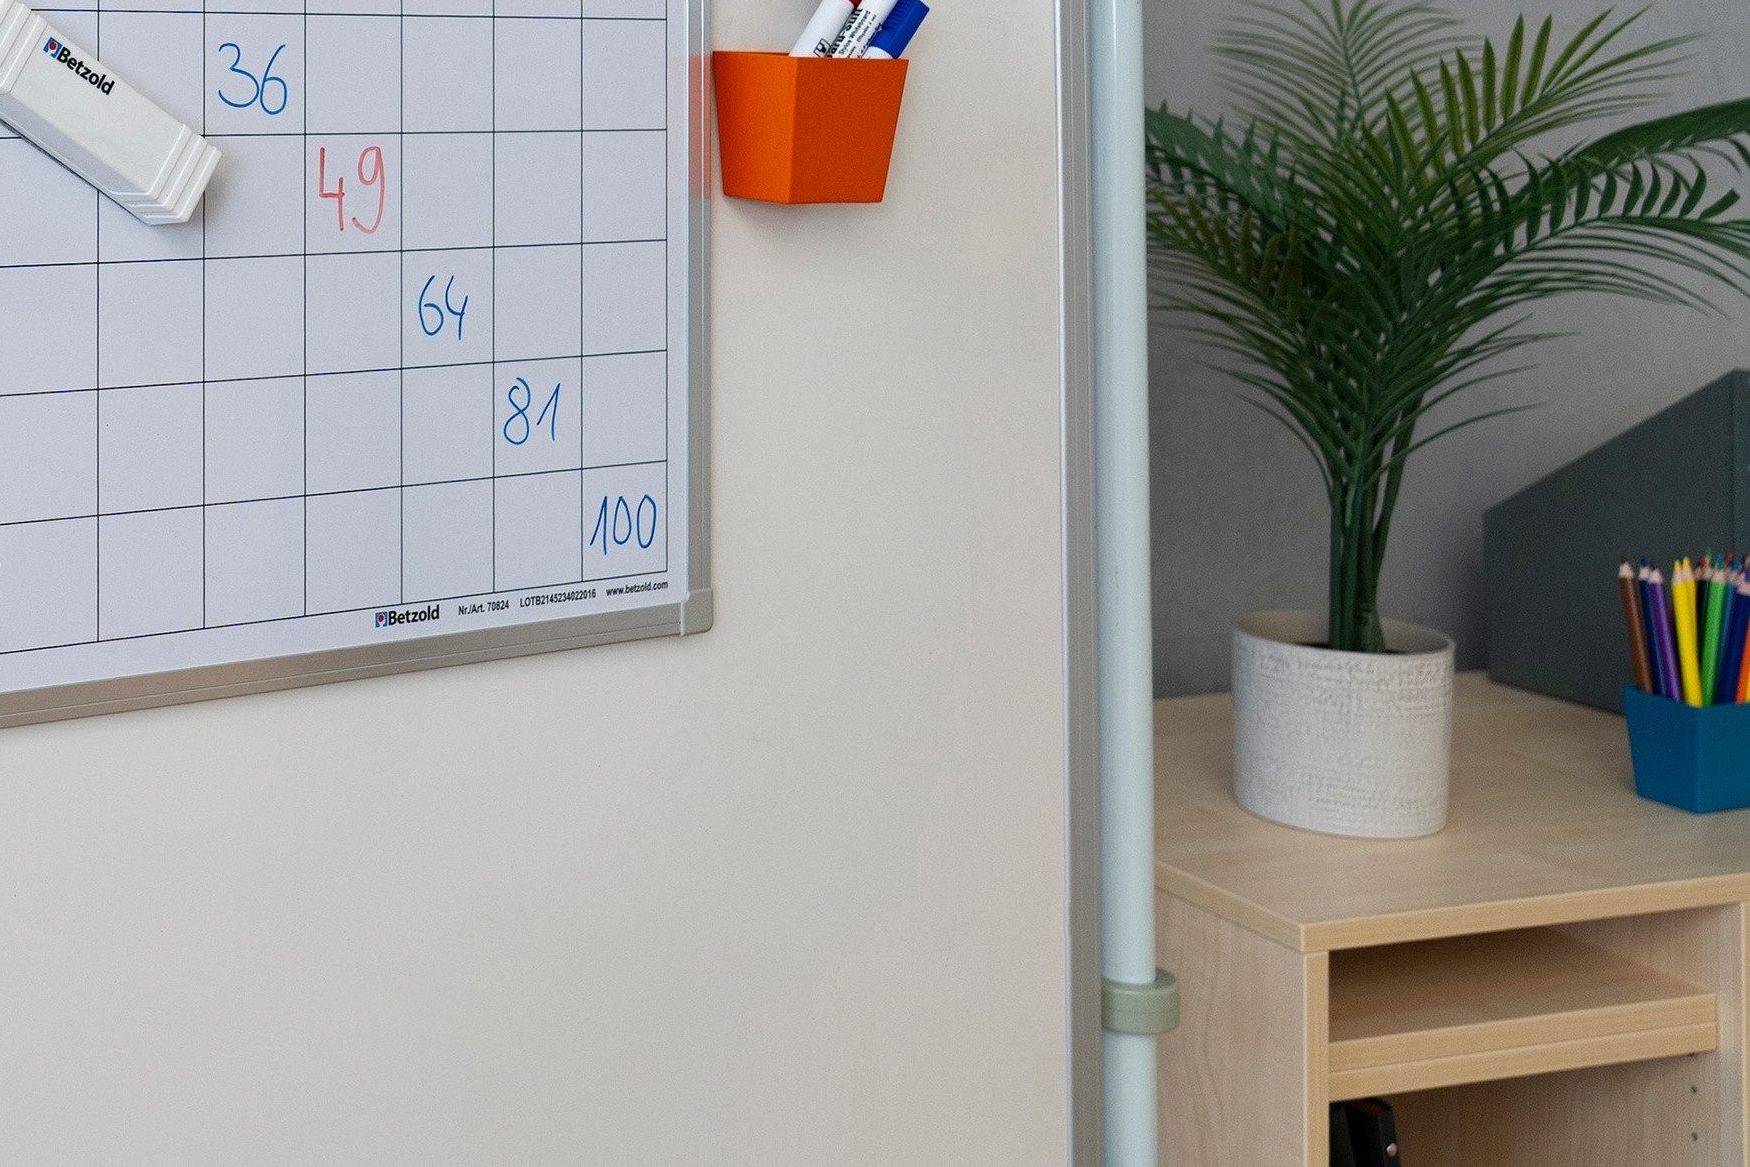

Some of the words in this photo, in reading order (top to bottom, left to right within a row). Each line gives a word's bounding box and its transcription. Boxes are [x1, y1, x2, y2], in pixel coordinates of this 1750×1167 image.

[57, 46, 115, 95] Betzold
[218, 42, 288, 115] 36
[318, 145, 385, 234] 49
[418, 275, 469, 341] 64
[503, 377, 561, 445] 81
[591, 493, 658, 554] 100
[388, 604, 440, 626] Betzold
[606, 580, 669, 597] www.betzold.com
